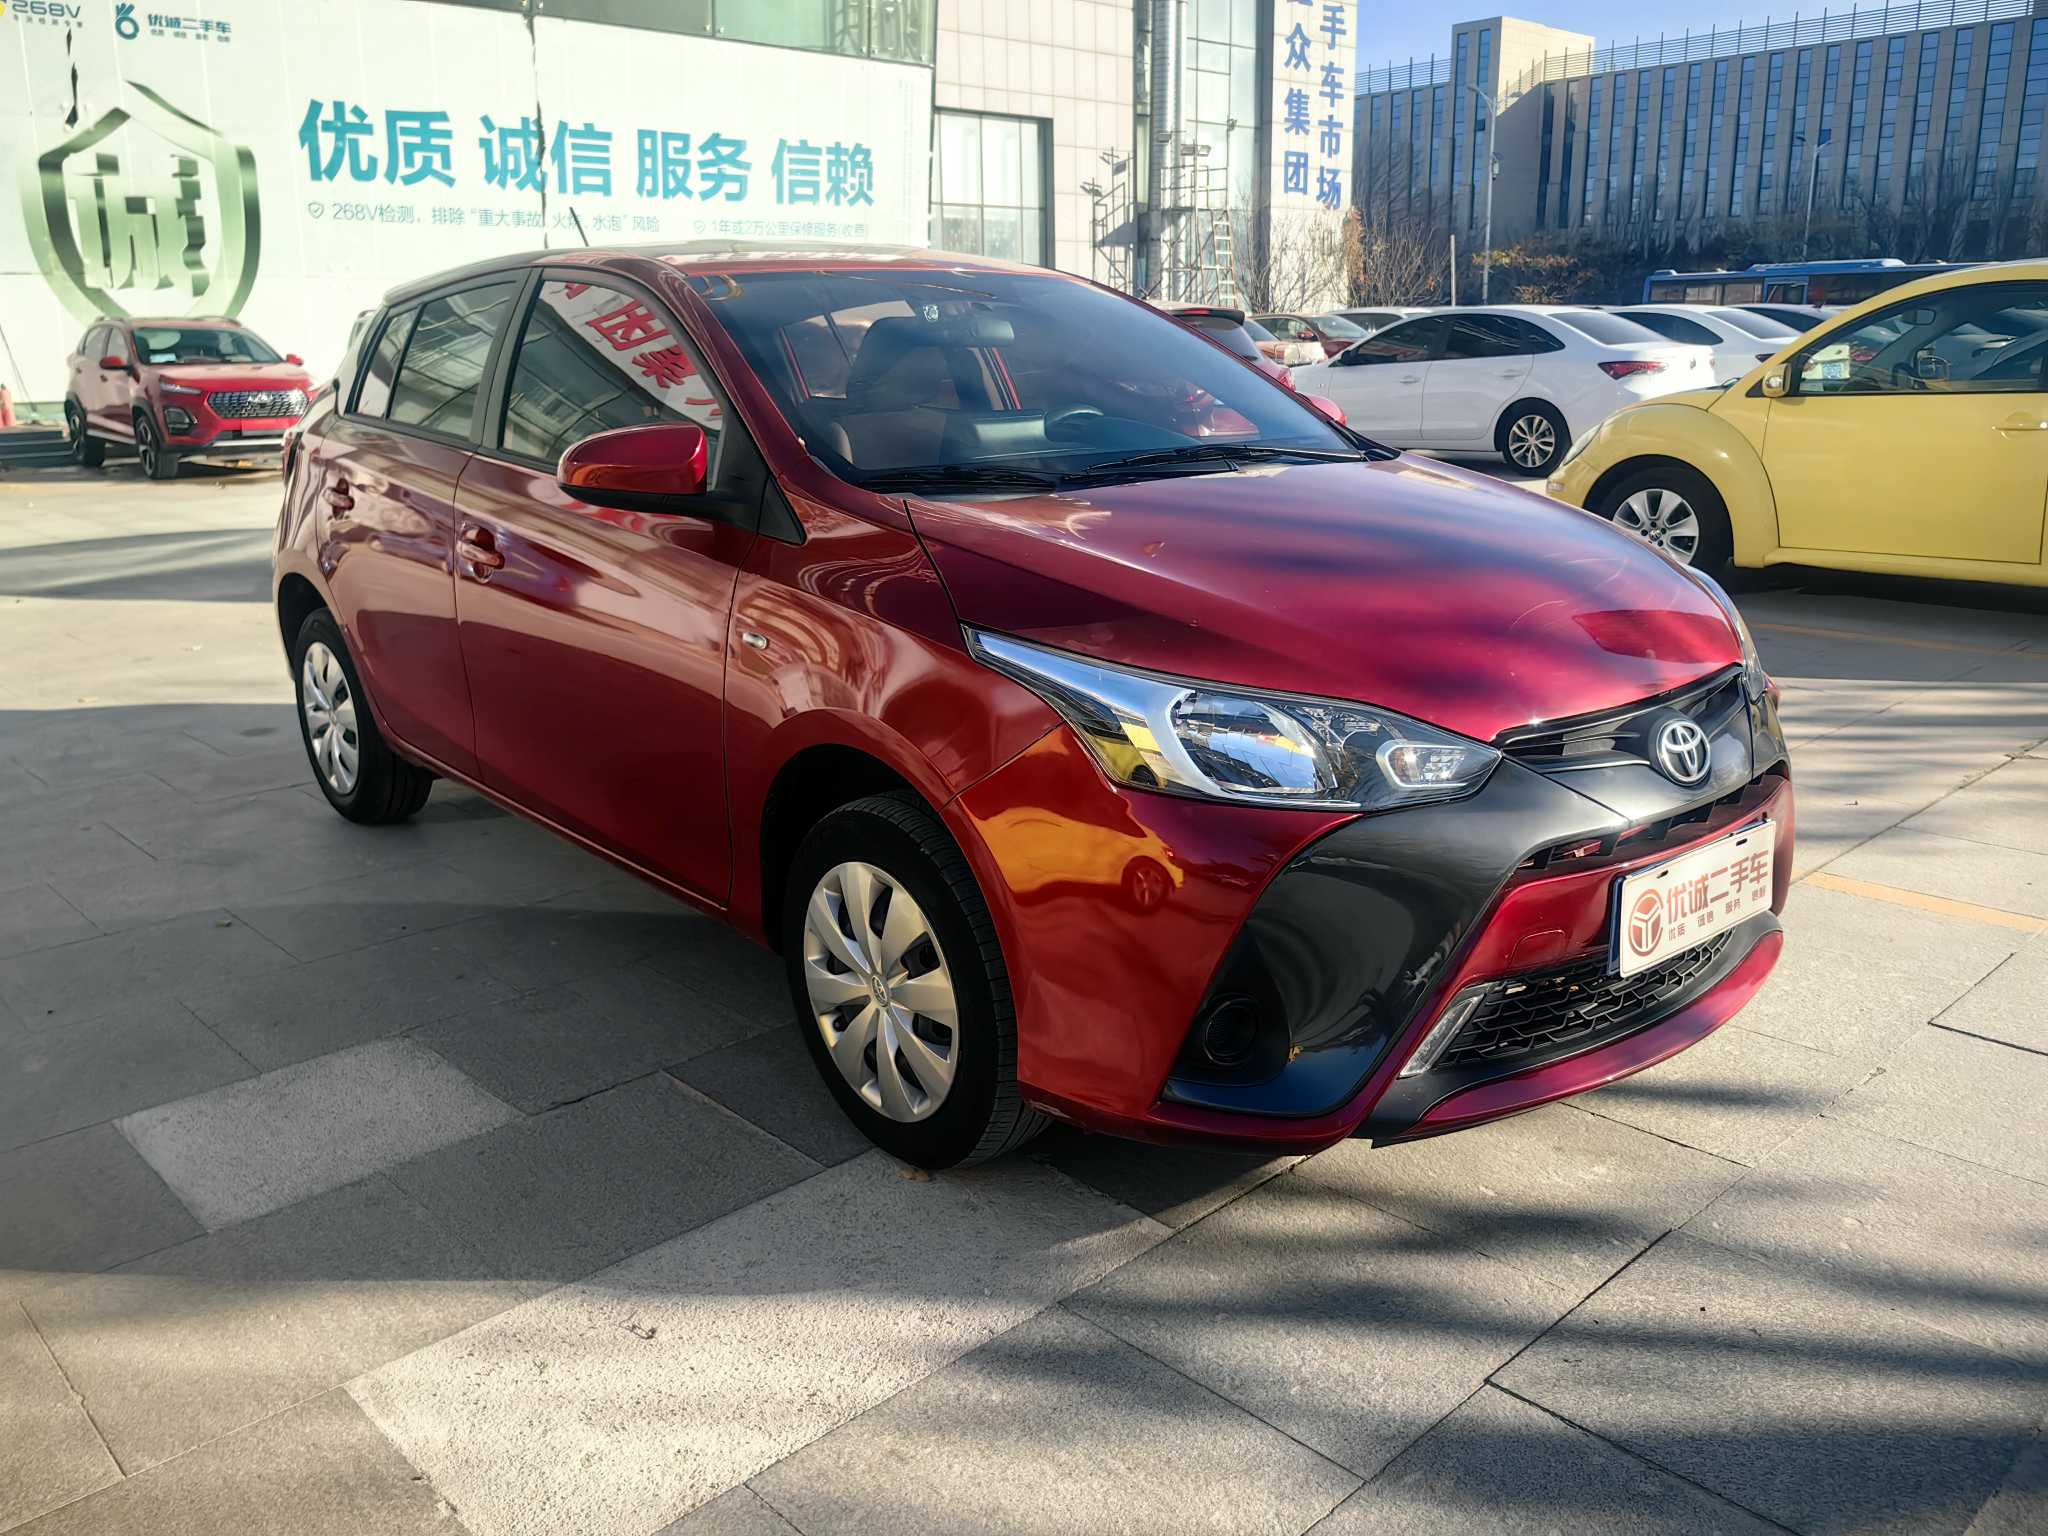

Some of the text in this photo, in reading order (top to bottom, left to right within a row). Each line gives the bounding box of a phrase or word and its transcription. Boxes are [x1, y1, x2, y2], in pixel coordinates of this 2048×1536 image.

[12, 0, 81, 18] 268V
[148, 14, 231, 33] 优诚二手车
[1284, 0, 1314, 196] 众集团
[1316, 4, 1347, 211] 手车市场
[298, 99, 876, 208] 优质 诚信 服务 信赖
[1667, 850, 1768, 924] 优诚二手车
